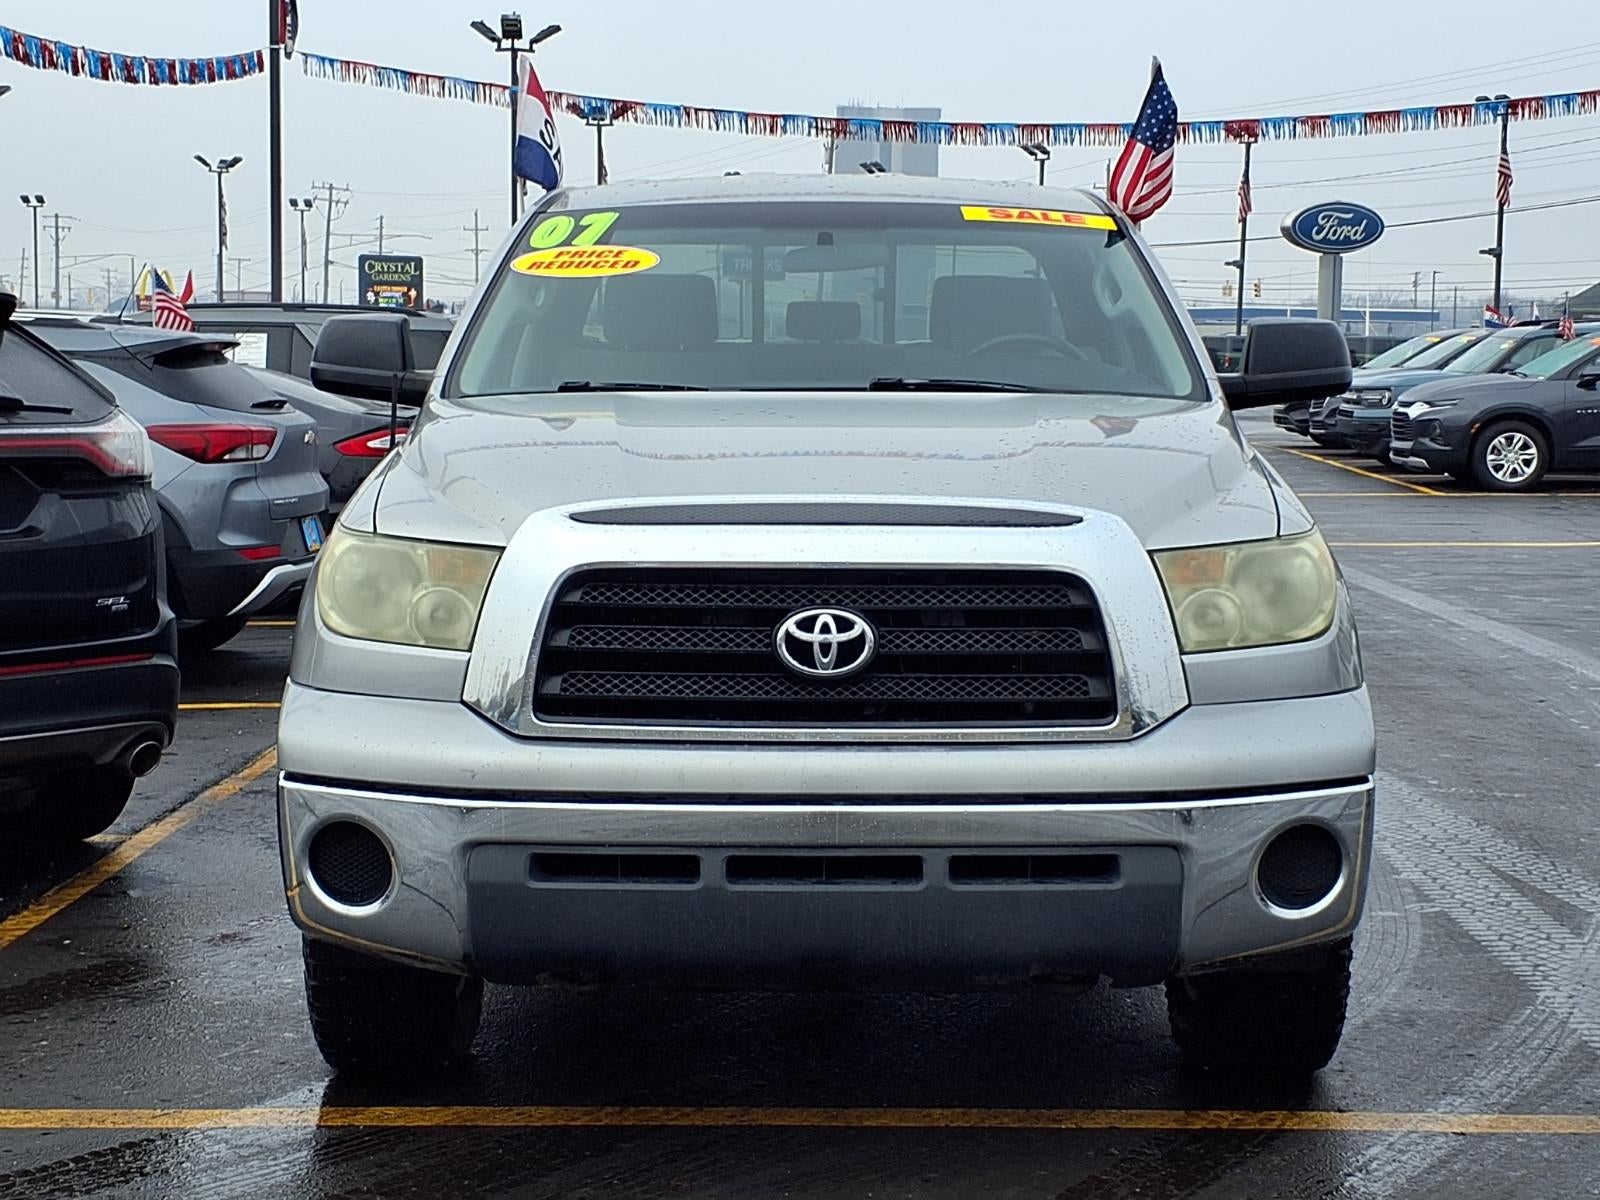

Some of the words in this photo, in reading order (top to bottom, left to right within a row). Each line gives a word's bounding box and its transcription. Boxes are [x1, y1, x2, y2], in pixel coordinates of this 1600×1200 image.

[987, 208, 1087, 224] SALE
[529, 211, 620, 249] 07
[1311, 211, 1367, 241] Ford
[553, 250, 629, 259] PRICE
[364, 260, 420, 275] CRYSTAL
[527, 259, 641, 271] REDUCED
[371, 273, 412, 281] GARDENS
